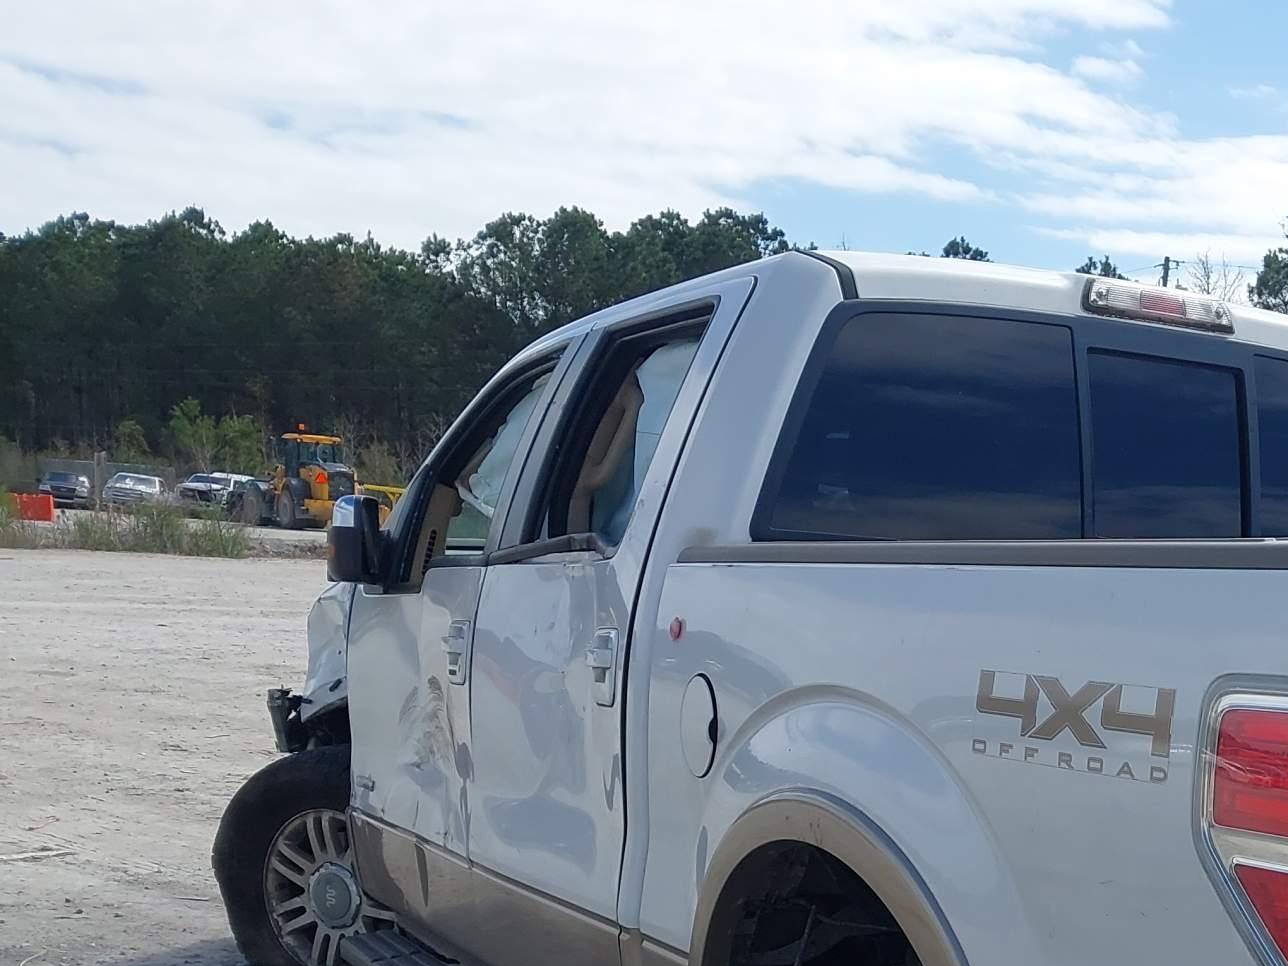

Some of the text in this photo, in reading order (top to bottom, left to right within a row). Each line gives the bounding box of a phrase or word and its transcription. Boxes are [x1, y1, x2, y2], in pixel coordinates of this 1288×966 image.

[976, 669, 1177, 758] 4X4
[972, 738, 1168, 783] OFF ROAD
